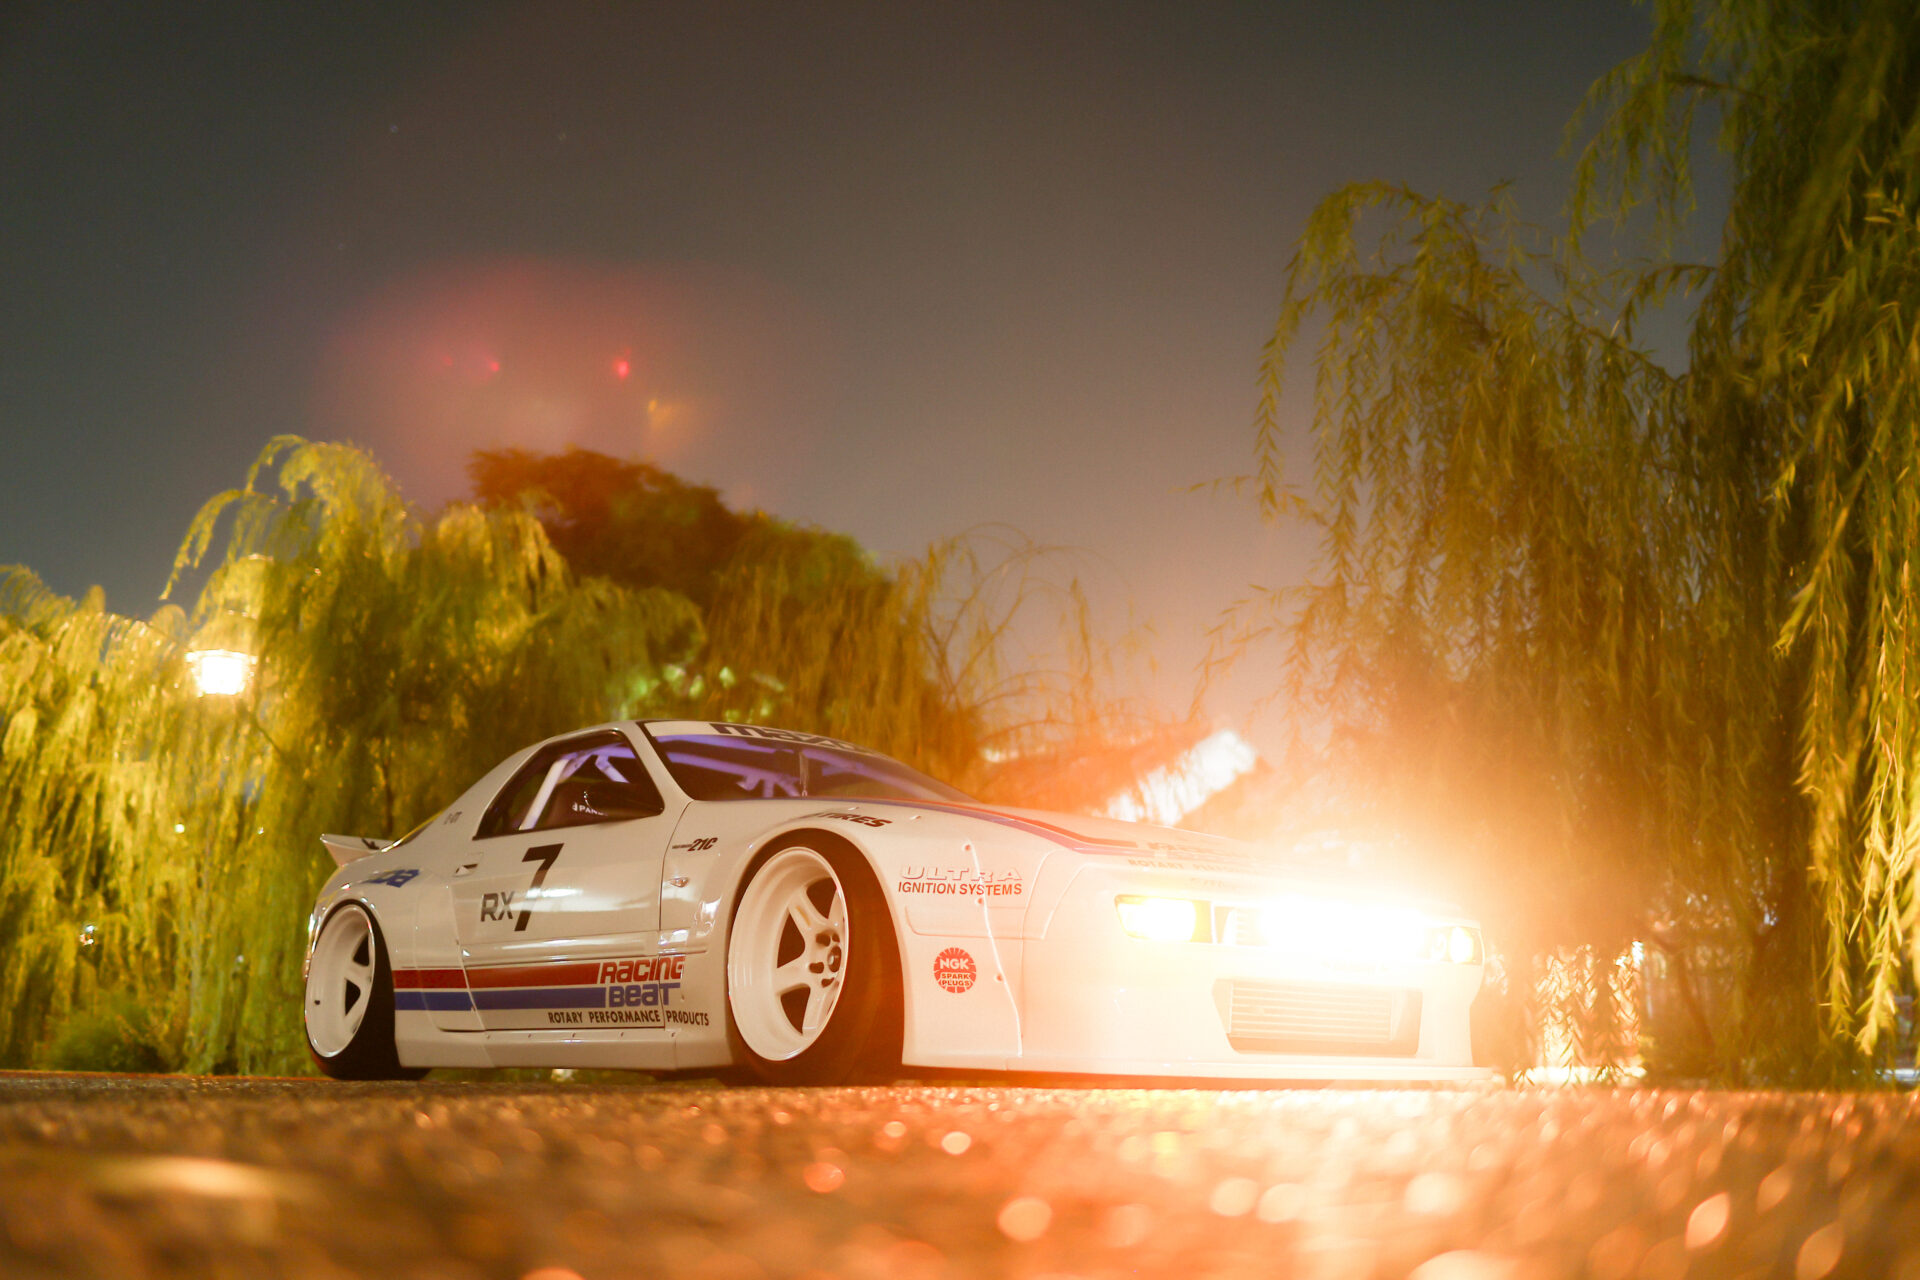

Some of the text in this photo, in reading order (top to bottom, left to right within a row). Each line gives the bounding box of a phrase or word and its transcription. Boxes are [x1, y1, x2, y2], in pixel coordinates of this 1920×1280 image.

[579, 804, 608, 816] PAN
[687, 837, 719, 851] 21C
[901, 865, 1023, 883] ULTRA
[481, 843, 565, 931] RX 7
[898, 881, 1023, 896] IGNITION SYSTEMS
[939, 958, 969, 970] NGK
[548, 1010, 709, 1026] ROTARY PERFORMANCE PRODUCTS
